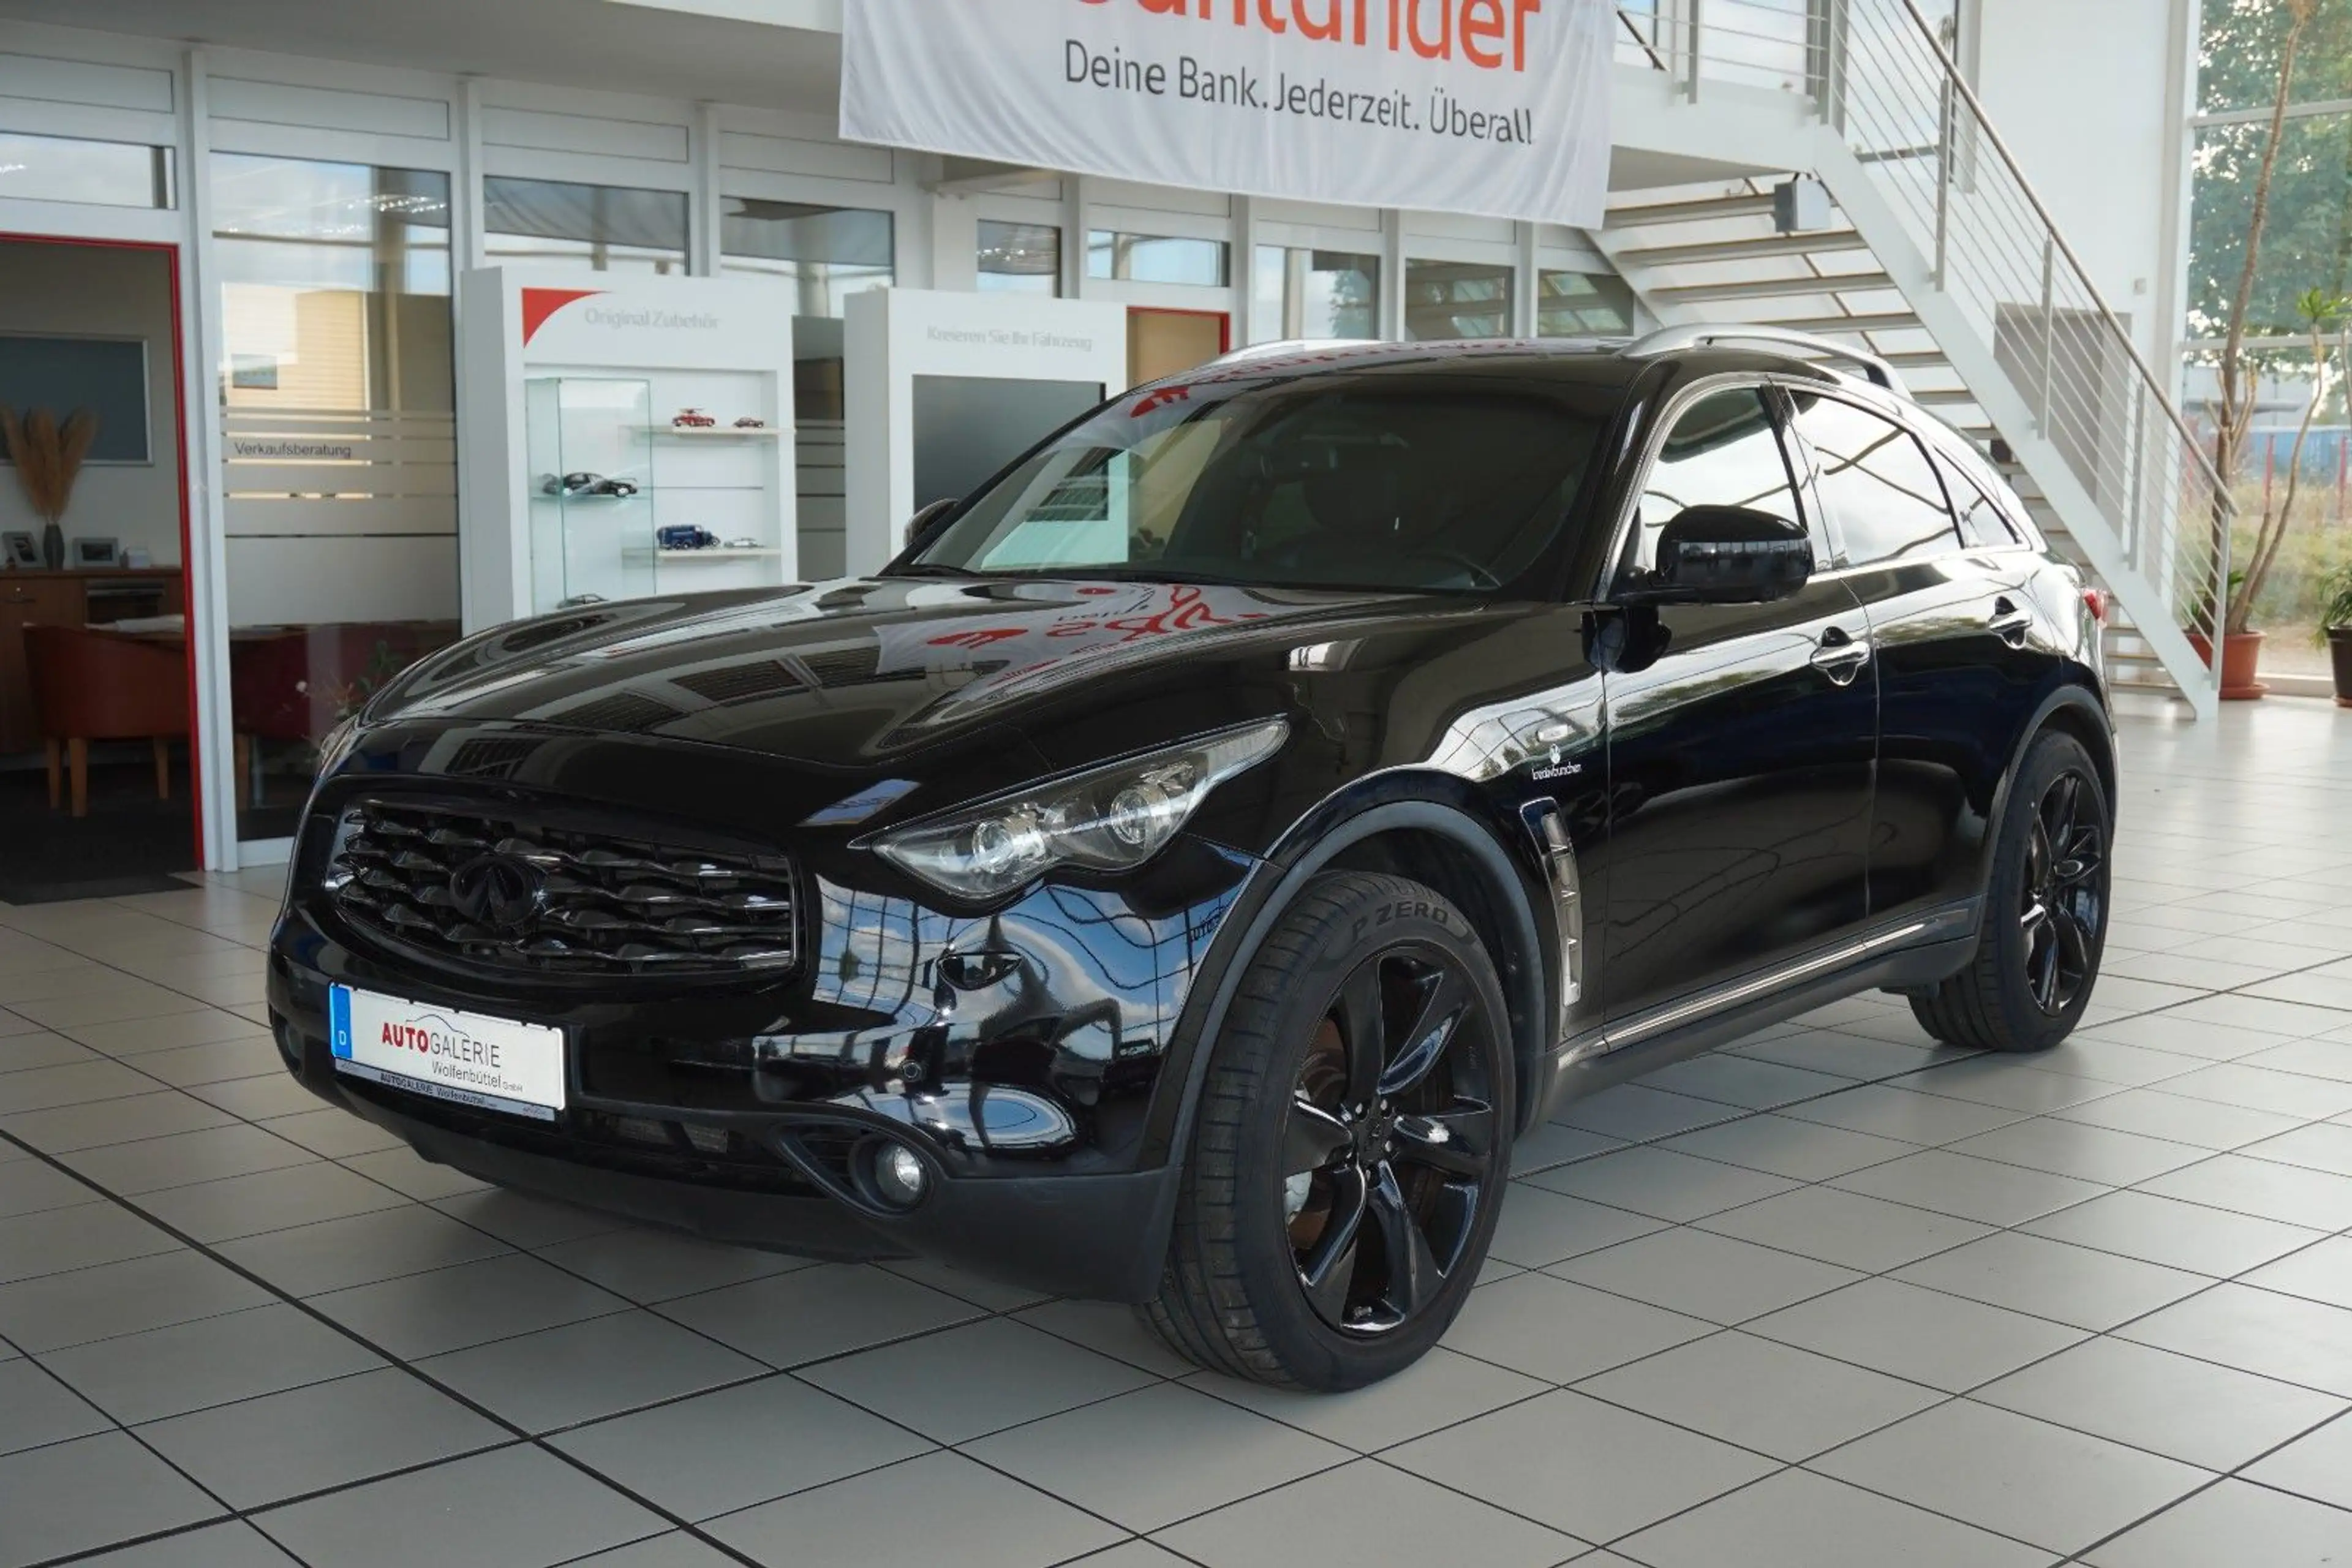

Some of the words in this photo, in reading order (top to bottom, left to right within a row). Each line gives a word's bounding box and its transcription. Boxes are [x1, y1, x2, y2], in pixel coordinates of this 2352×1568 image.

[1066, 39, 1166, 95] Deine
[1179, 56, 1268, 108] Bank.
[1274, 72, 1420, 130] Jederzeit.
[584, 307, 649, 330] Original
[652, 309, 719, 330] Zubehör
[989, 329, 1009, 345] Sie
[1012, 331, 1029, 345] Ihr
[1032, 331, 1093, 352] Fahrzeug
[234, 442, 352, 459] Verkaufsberatung
[1352, 915, 1369, 943] P
[1376, 900, 1449, 926] ZERO
[337, 1030, 347, 1046] D
[382, 1022, 501, 1068] AUTOGALERIE
[432, 1060, 501, 1088] Wolfenbüttel
